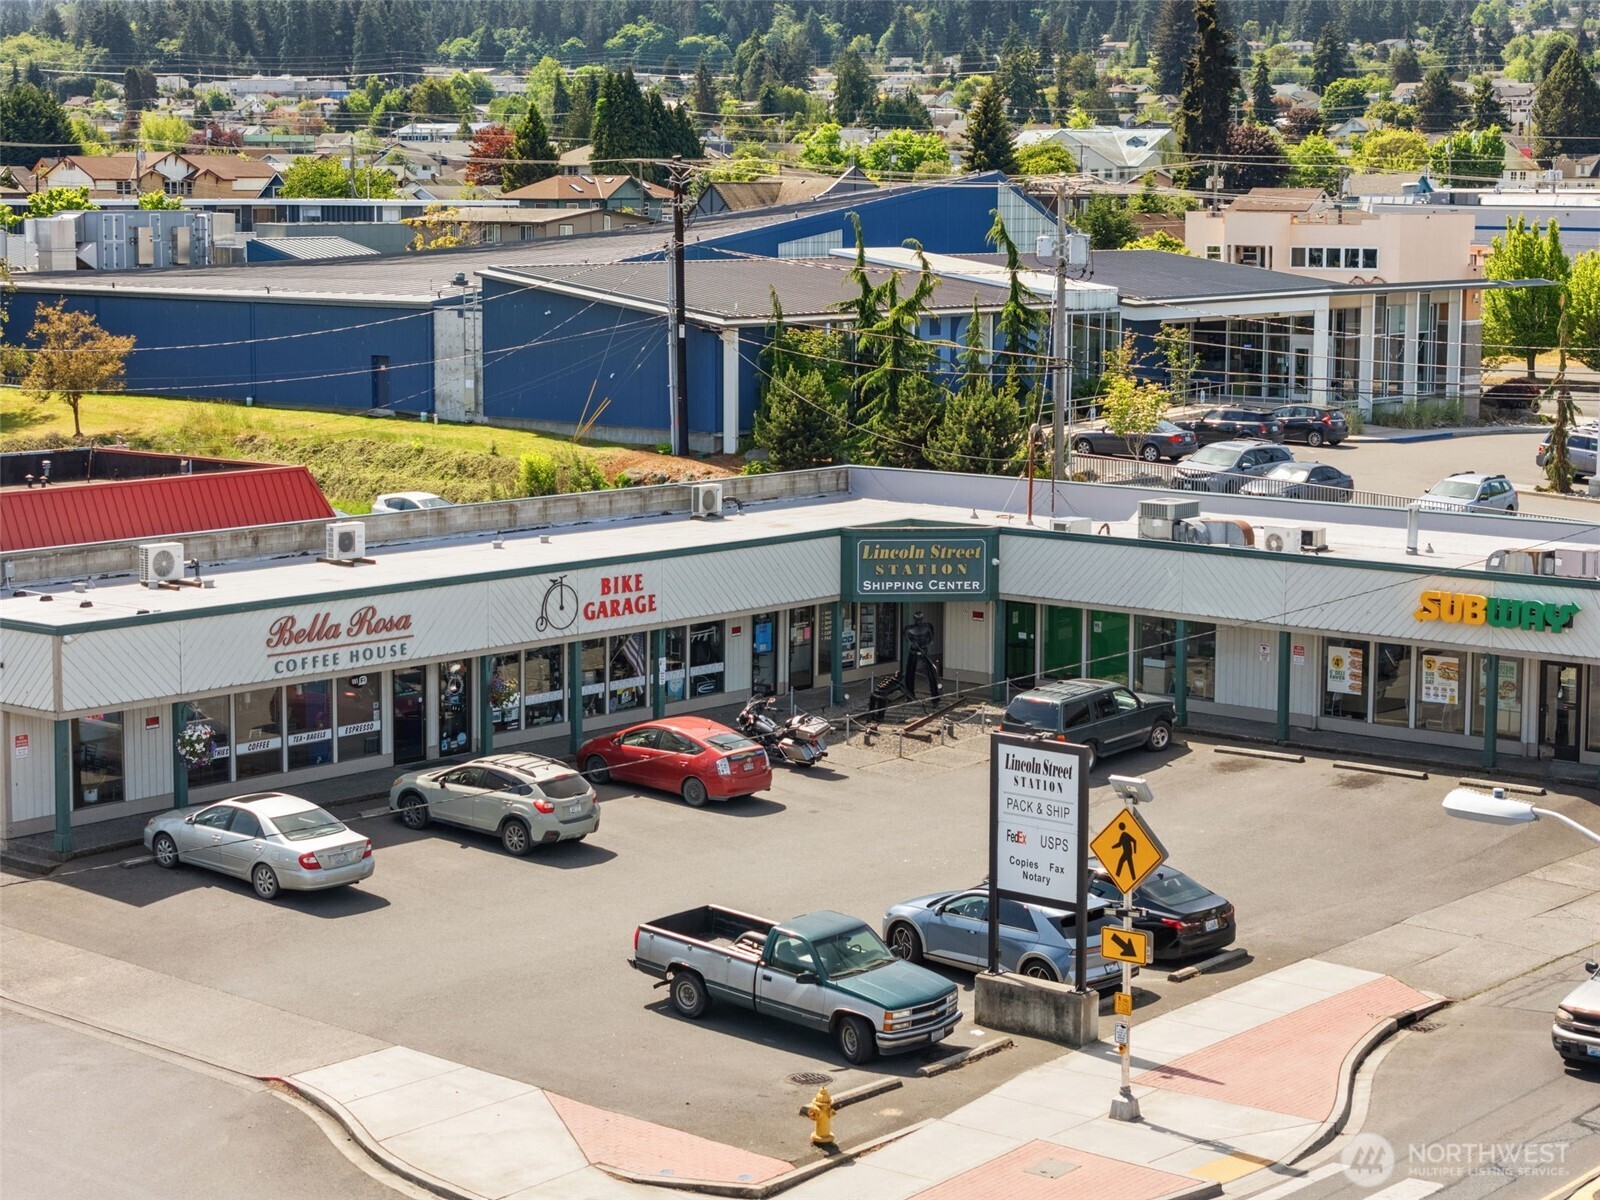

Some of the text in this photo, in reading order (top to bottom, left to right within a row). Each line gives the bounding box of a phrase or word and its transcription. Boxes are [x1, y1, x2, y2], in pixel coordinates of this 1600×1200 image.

[862, 544, 982, 561] Lincoln Street
[875, 563, 968, 576] STATION
[600, 573, 644, 596] BIKE
[863, 580, 981, 591] SHIPPING CENTER
[584, 594, 656, 621] GARAGE
[1412, 589, 1583, 634] SUBWAY
[266, 605, 412, 648] Bella Rosa
[274, 643, 408, 674] COFFEE HOUSE
[344, 722, 374, 735] ESPRESSO
[213, 748, 229, 757] THIES
[247, 740, 270, 752] COFFEE
[1004, 752, 1074, 780] Lincoln Street
[1013, 776, 1064, 794] STATION
[1006, 797, 1071, 819] PACK & SHIP
[1006, 828, 1027, 845] FedEx
[1040, 835, 1069, 853] USPS
[1009, 856, 1039, 871] Copies
[1049, 862, 1065, 874] Fax
[1022, 870, 1051, 886] Notary
